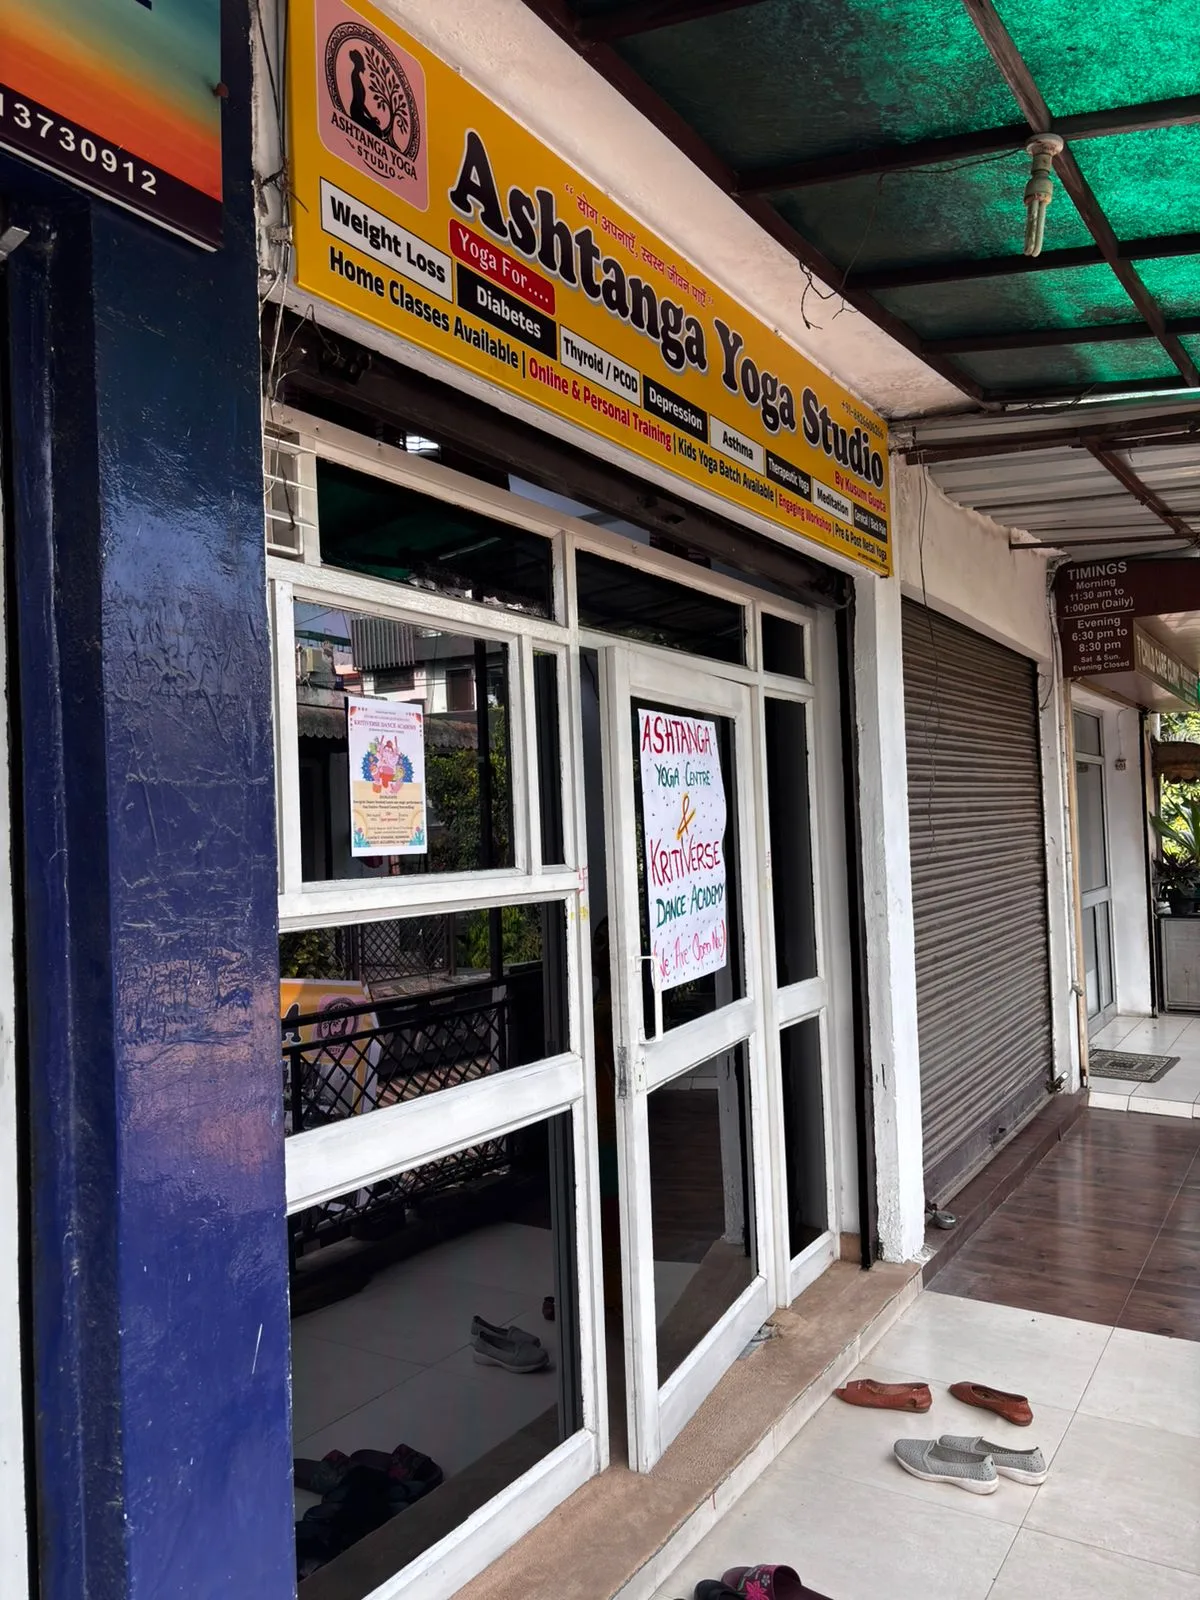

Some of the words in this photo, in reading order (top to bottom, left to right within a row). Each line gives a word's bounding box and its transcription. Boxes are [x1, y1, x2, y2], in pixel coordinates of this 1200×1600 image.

[331, 112, 388, 161] ASHTANGA
[390, 150, 418, 181] YOGA
[357, 146, 396, 178] STUDIO
[577, 195, 599, 225] योग
[330, 196, 401, 258] Weight
[406, 243, 446, 283] Loss
[458, 228, 497, 271] Yoga
[449, 129, 708, 372] Ashtanga
[714, 318, 797, 434] Yoga
[802, 386, 885, 490] Studio
[476, 285, 541, 339] Diabetes
[563, 337, 604, 375] Thyroid
[613, 365, 638, 394] PCOD
[330, 246, 385, 297] Home
[389, 280, 450, 331] Classes
[454, 316, 519, 369] Available
[529, 357, 569, 394] Online
[572, 380, 581, 401] &
[584, 385, 631, 426] Personal
[632, 412, 672, 452] Training
[678, 437, 697, 461] Kids
[698, 448, 718, 474] Yoga
[719, 460, 741, 485] Batch
[743, 473, 774, 502] Available
[779, 494, 805, 521] Engaging
[805, 508, 832, 533] Workshop
[835, 523, 845, 540] Pre
[850, 532, 862, 548] Post
[649, 387, 703, 431] Depression
[722, 431, 754, 460] Asthma
[799, 477, 810, 495] Yoga
[834, 471, 843, 490] By
[844, 478, 868, 500] Kusum
[868, 492, 887, 513] Gupta
[816, 488, 849, 517] Meditation
[1067, 562, 1127, 581] TIMINGS
[1076, 578, 1116, 590] Morning
[1064, 603, 1099, 613] 1:00pm
[1102, 597, 1134, 610] (Daily)
[1070, 591, 1095, 601] 11:30
[1097, 590, 1112, 598] am
[1114, 588, 1124, 596] to
[1072, 631, 1094, 641] 6:30
[1097, 630, 1114, 640] pm
[1117, 628, 1128, 636] to
[1077, 617, 1121, 629] Evening
[1079, 642, 1101, 652] 8:30
[1104, 641, 1121, 651] pm
[1073, 663, 1102, 672] Evening
[1104, 660, 1130, 669] Closed
[642, 715, 712, 756] ASHTANGA
[654, 763, 680, 788] YOGA
[677, 792, 696, 839] &
[656, 894, 687, 928] DANCE
